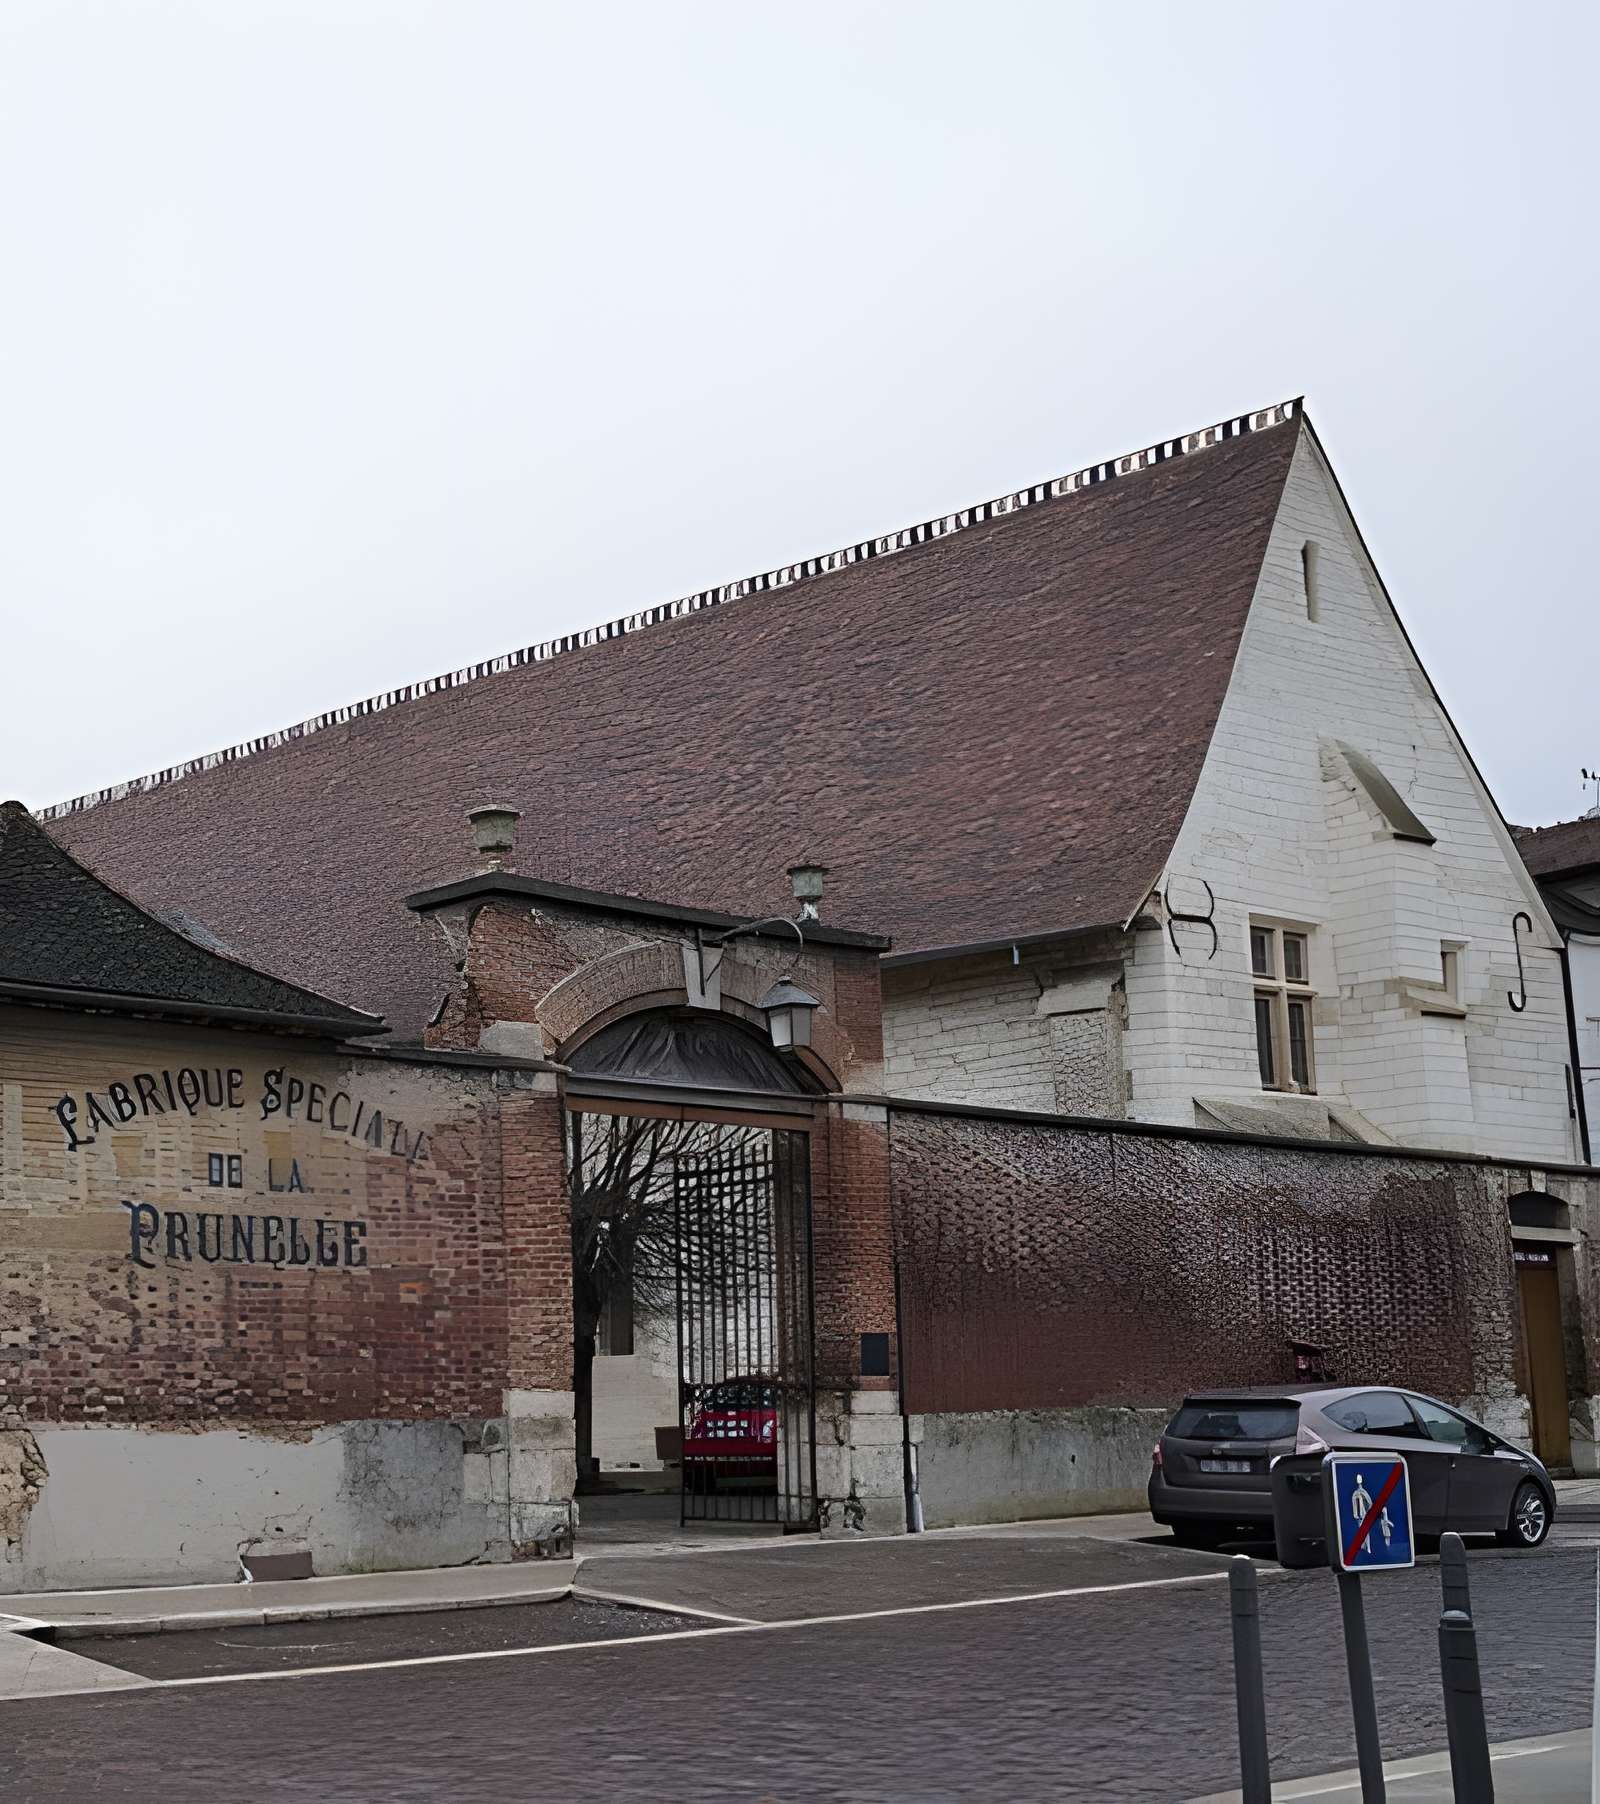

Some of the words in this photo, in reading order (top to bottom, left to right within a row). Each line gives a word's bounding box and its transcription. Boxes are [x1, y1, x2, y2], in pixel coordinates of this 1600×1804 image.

[53, 1068, 244, 1152] FABRIQUE
[208, 1152, 243, 1189] DE
[268, 1158, 304, 1193] LA
